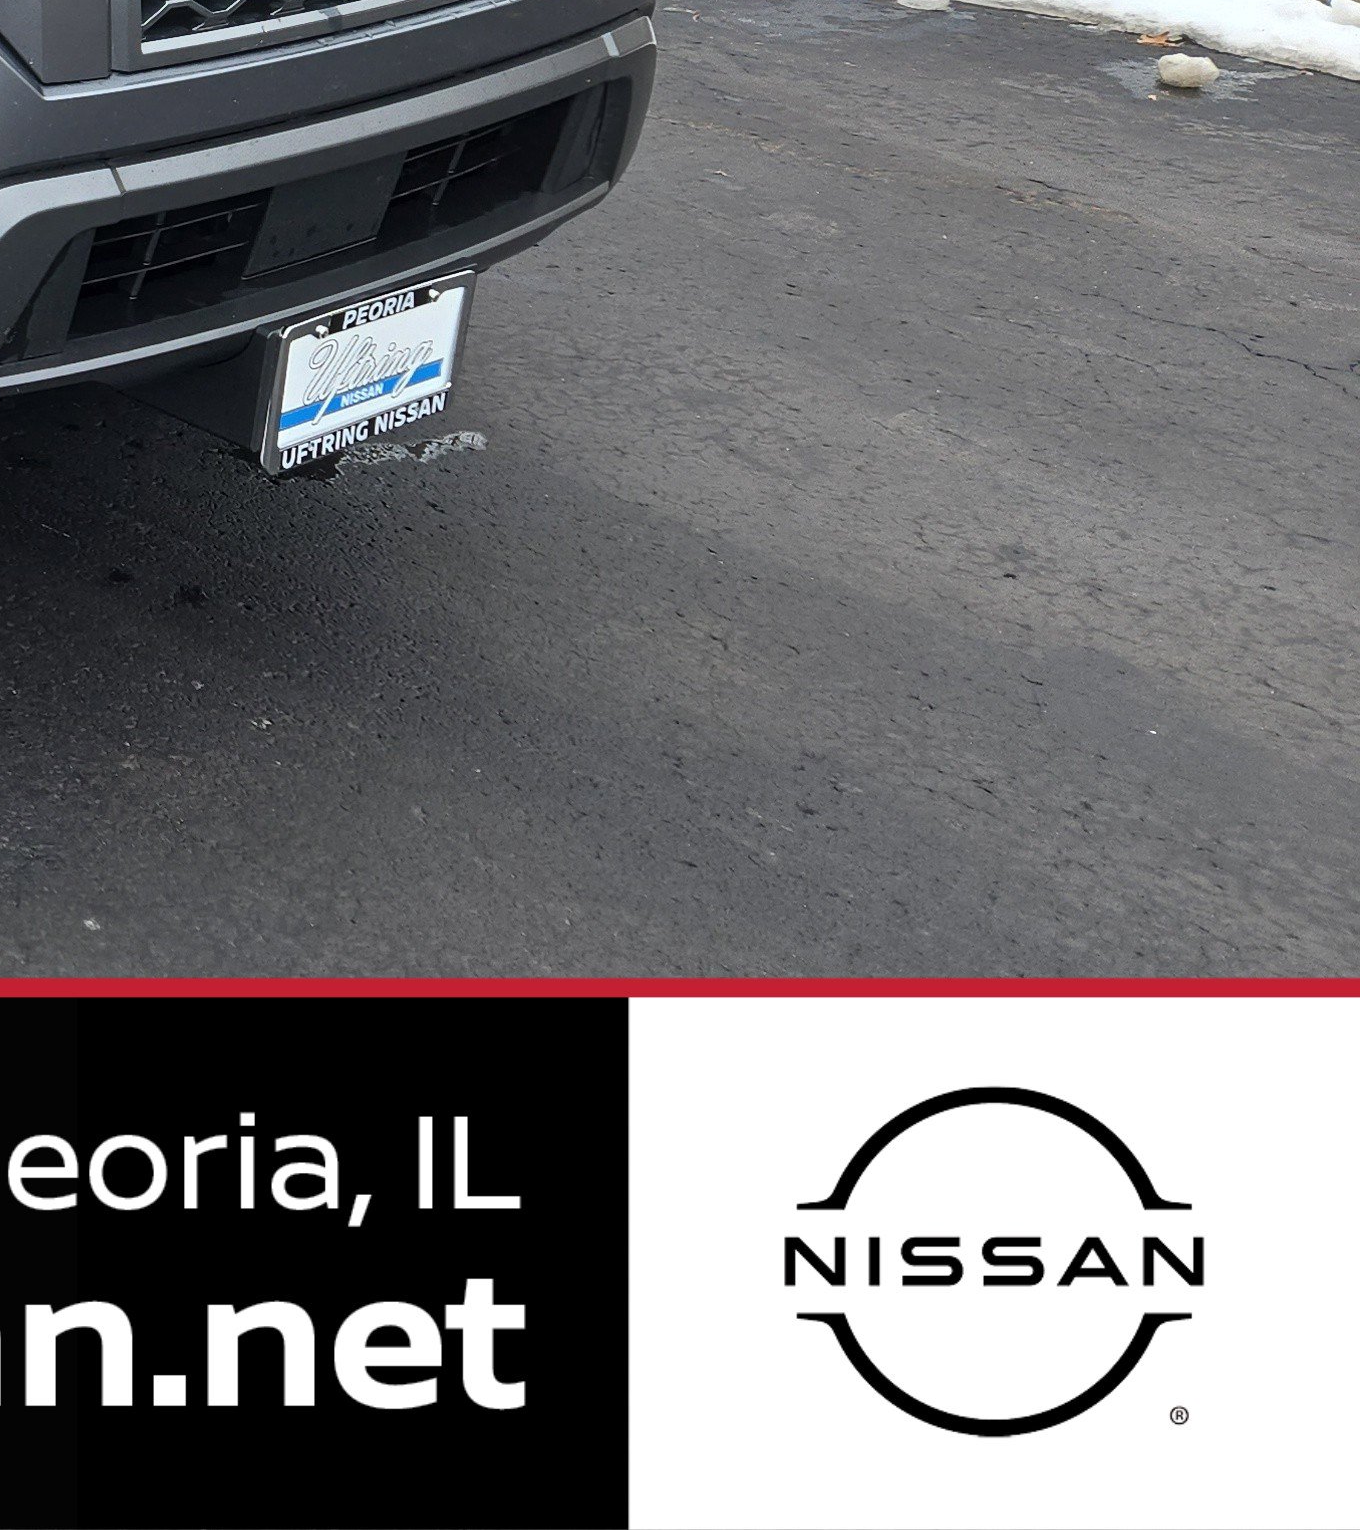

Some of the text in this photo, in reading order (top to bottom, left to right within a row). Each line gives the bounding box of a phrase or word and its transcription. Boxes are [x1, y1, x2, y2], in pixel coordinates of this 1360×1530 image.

[342, 291, 416, 330] PEORIA
[303, 334, 434, 426] Uftring
[340, 383, 385, 408] NISSAN
[281, 392, 448, 470] UFTRING NISSAN
